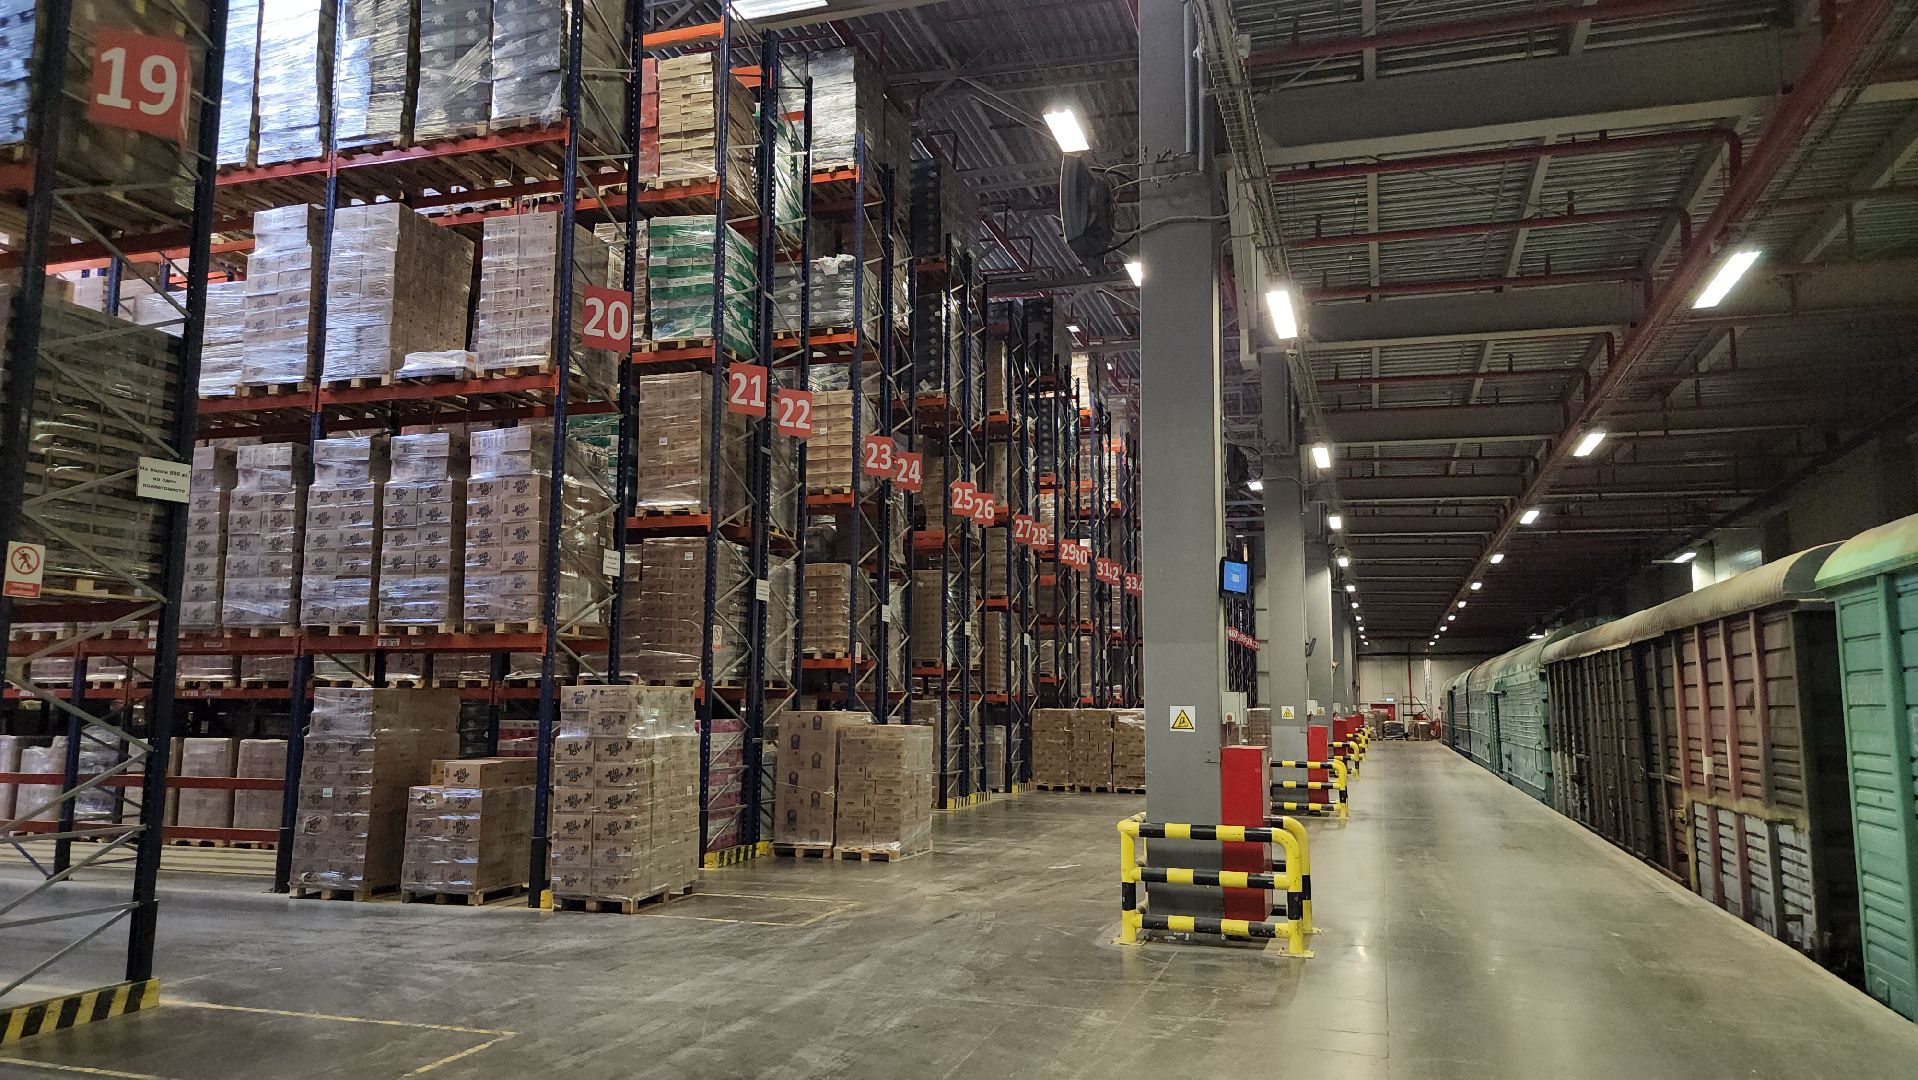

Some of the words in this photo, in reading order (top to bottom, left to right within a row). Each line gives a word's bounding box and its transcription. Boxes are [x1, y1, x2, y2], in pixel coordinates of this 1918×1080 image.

[95, 47, 178, 117] 19
[583, 297, 629, 341] 20
[730, 372, 765, 408] 21
[780, 397, 810, 430] 22
[865, 442, 891, 470] 23
[896, 458, 921, 483] 24
[953, 487, 974, 510] 25
[974, 498, 994, 520] 26
[1015, 519, 1032, 539] 27
[1032, 527, 1047, 545] 28
[1061, 543, 1076, 560] 29
[1096, 561, 1110, 576] 31
[1125, 576, 1137, 590] 33
